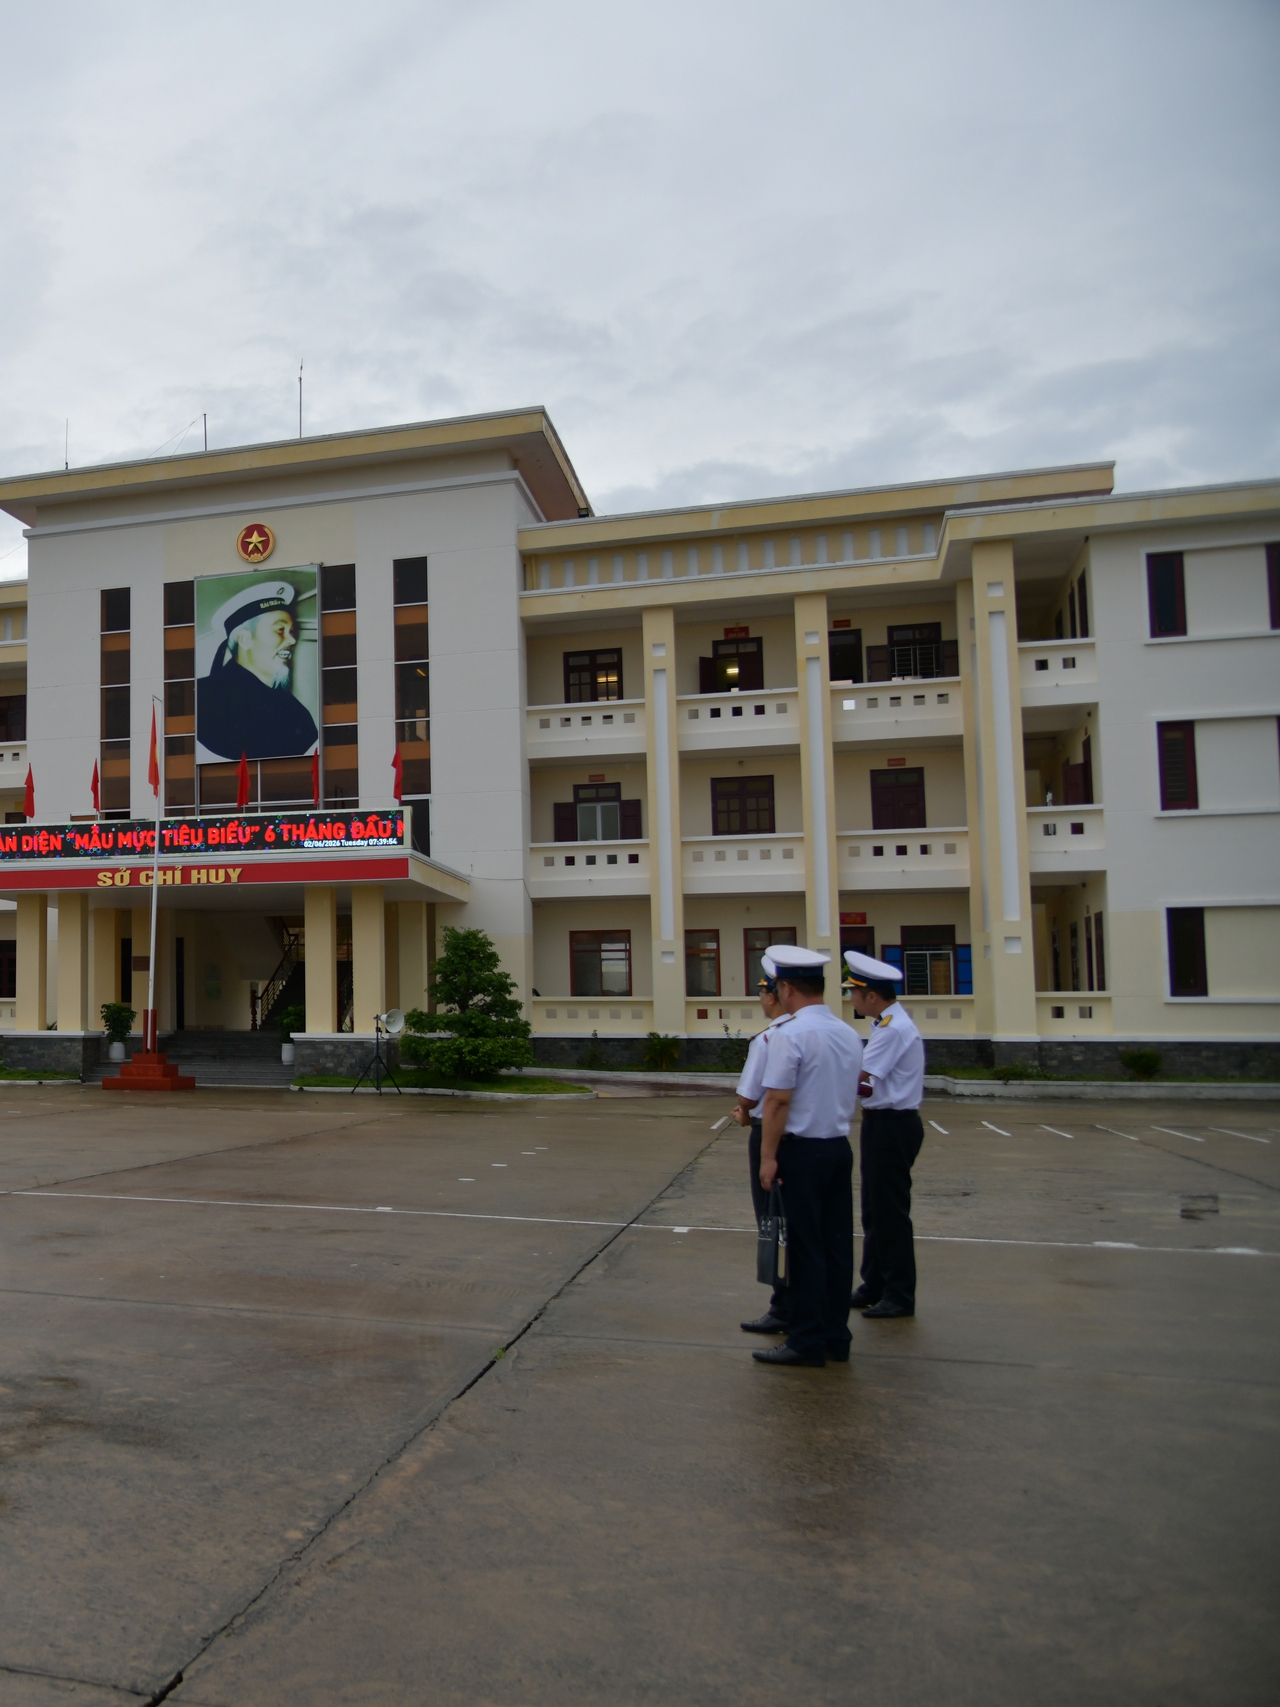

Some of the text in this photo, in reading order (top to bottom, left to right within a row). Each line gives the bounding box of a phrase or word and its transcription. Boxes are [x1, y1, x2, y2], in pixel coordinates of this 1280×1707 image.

[22, 829, 62, 855] DIỆN
[117, 829, 157, 852] MỰC
[162, 823, 203, 847] TIÊU
[264, 825, 276, 843] 6
[279, 818, 346, 842] THÁNG
[351, 814, 392, 839] ĐẦU
[341, 839, 368, 847] Tuesday
[368, 837, 398, 846] 07:39:54
[96, 865, 242, 887] SỞ CHỈ HUY
